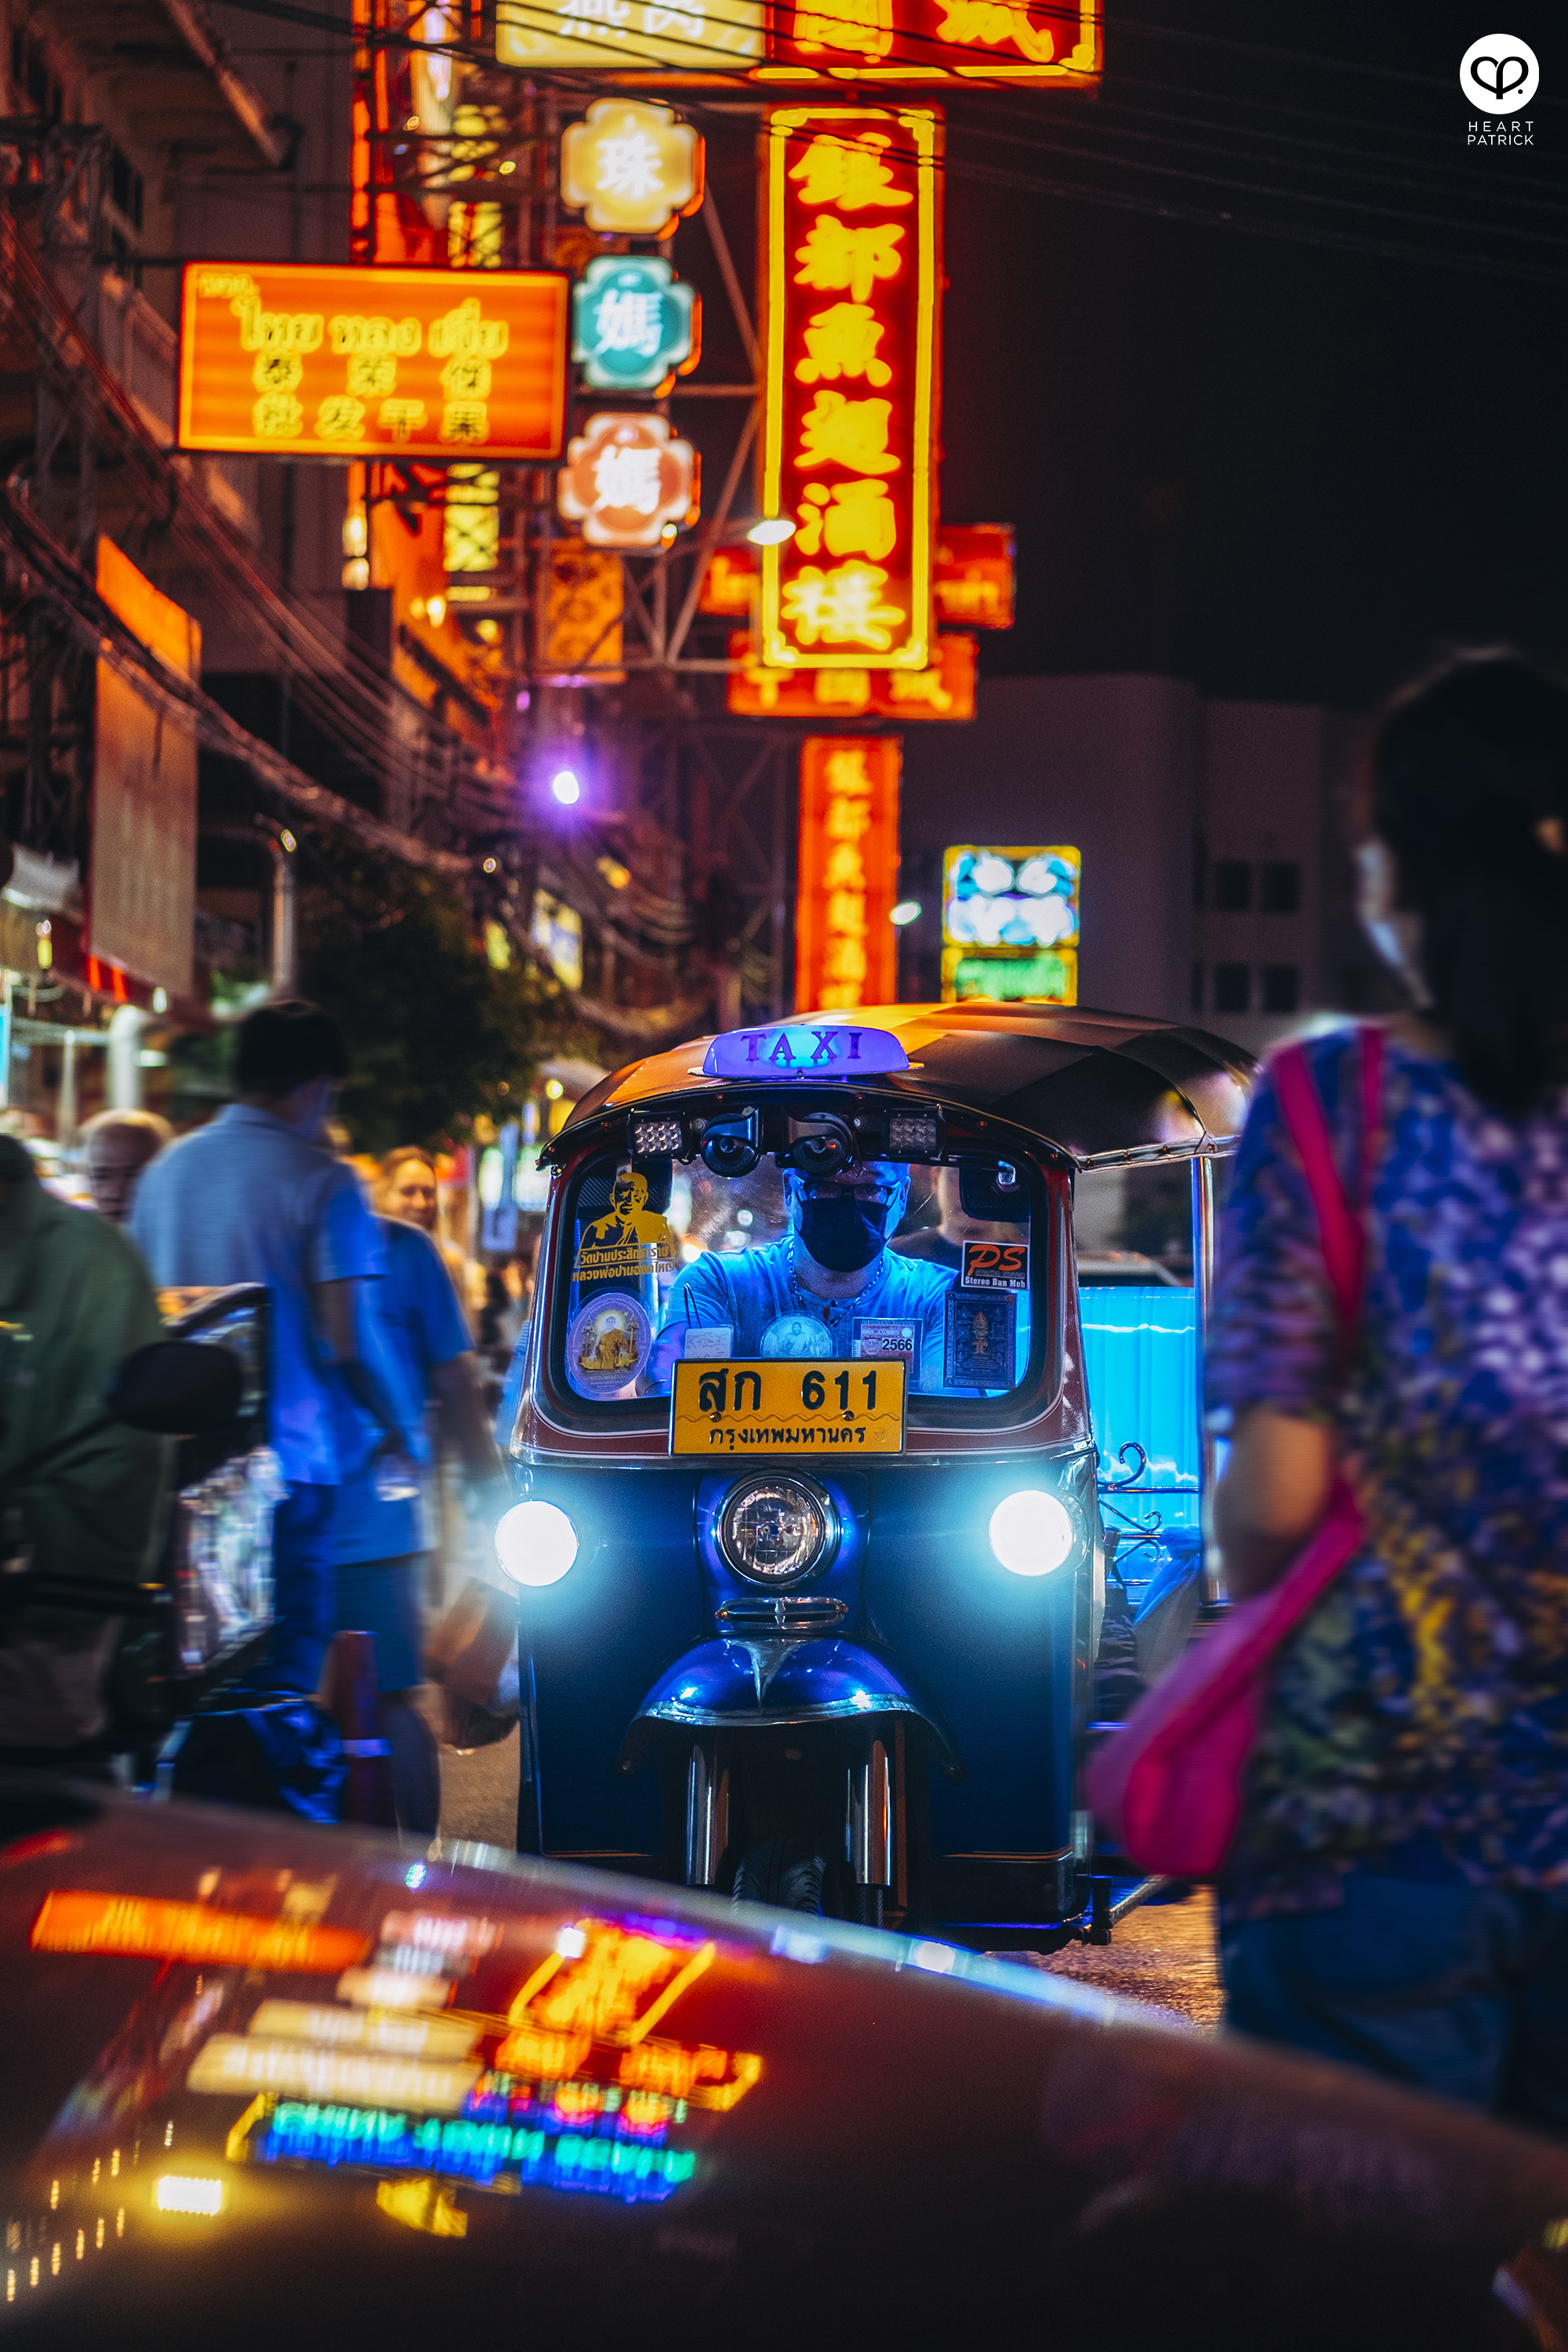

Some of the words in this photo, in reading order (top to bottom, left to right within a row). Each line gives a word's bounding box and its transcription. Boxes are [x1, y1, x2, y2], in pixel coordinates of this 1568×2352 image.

[740, 1031, 863, 1062] TAXI
[967, 1244, 1025, 1276] PS
[965, 1276, 990, 1286] Stereo
[992, 1278, 1007, 1287] Ban
[1010, 1279, 1025, 1288] Moh
[882, 1338, 913, 1351] 2566
[800, 1370, 877, 1411] 611
[710, 1426, 866, 1451] กรุงเทพมหานคร
